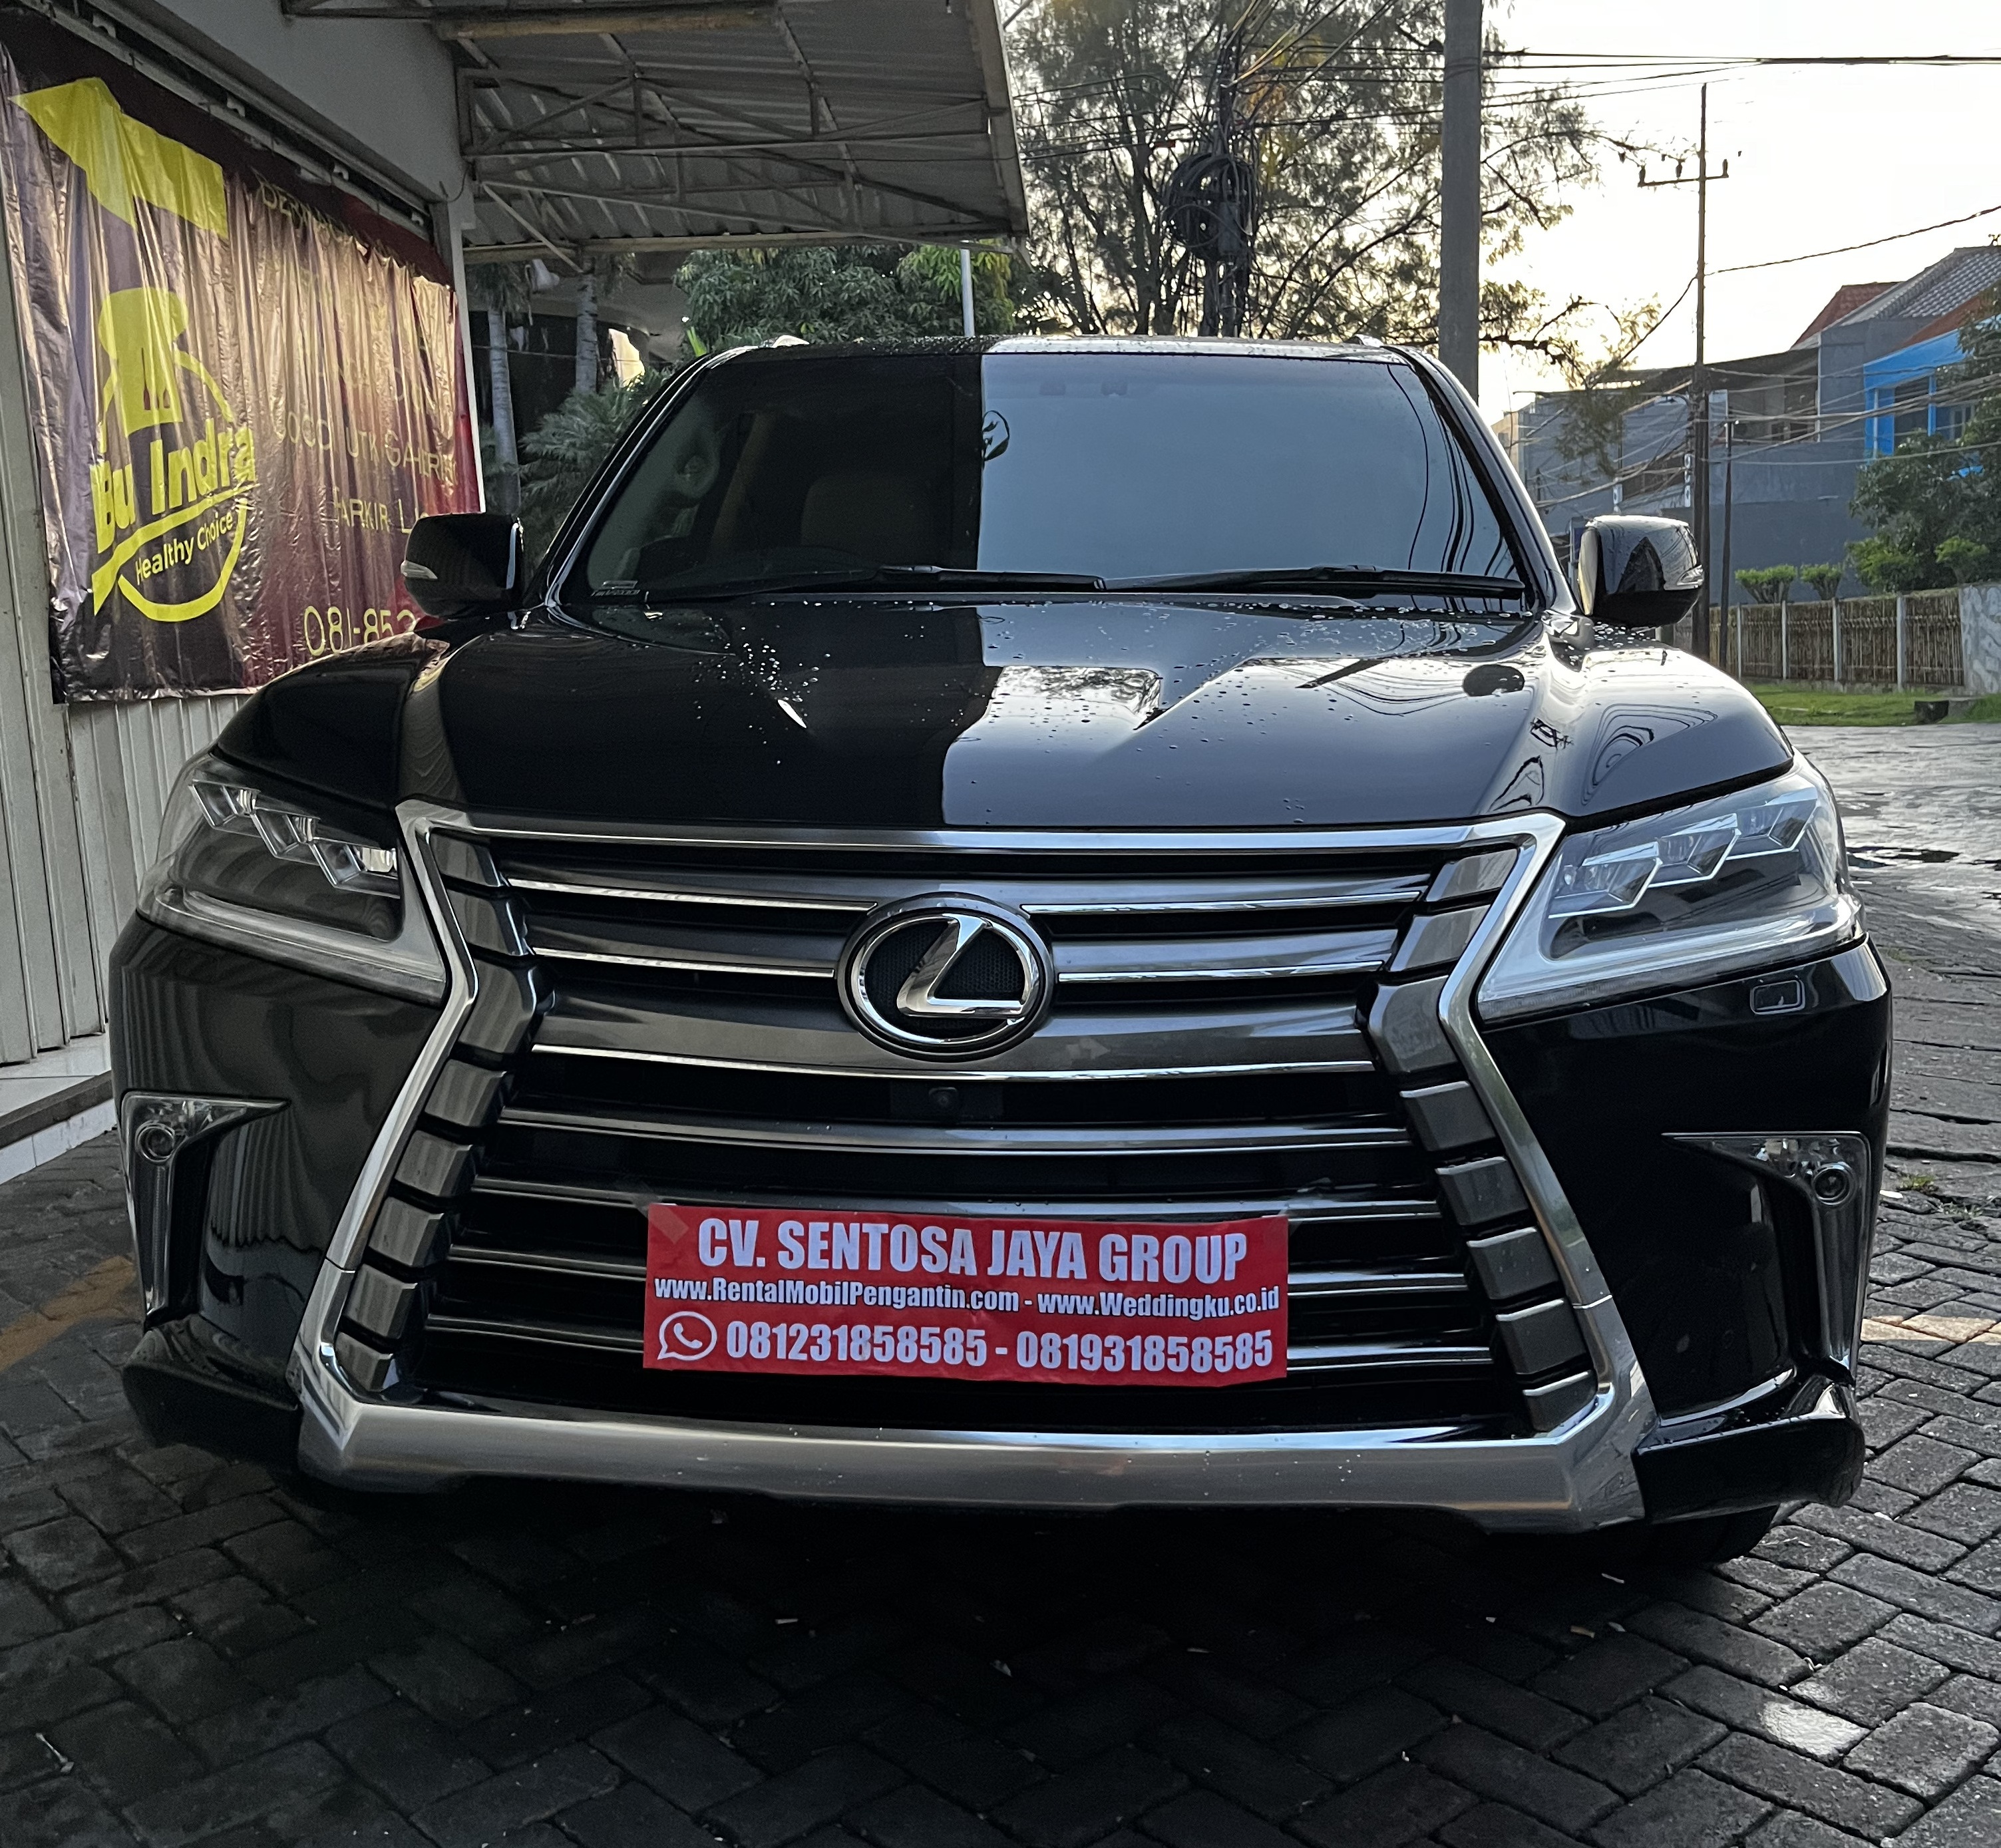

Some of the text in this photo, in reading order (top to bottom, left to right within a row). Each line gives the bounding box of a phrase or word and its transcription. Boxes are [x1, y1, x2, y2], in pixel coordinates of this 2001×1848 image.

[89, 418, 256, 554] Bu Indra
[135, 510, 234, 586] Healthy Choice
[699, 1218, 1247, 1284] CV. SENTOSA JAYA GROUP
[654, 1276, 1019, 1313] www.RentalMobilPengantin.com
[1036, 1285, 1280, 1322] www.Weddingku.co.id
[727, 1320, 988, 1367] 081231858585
[1016, 1329, 1273, 1374] 081931858585
